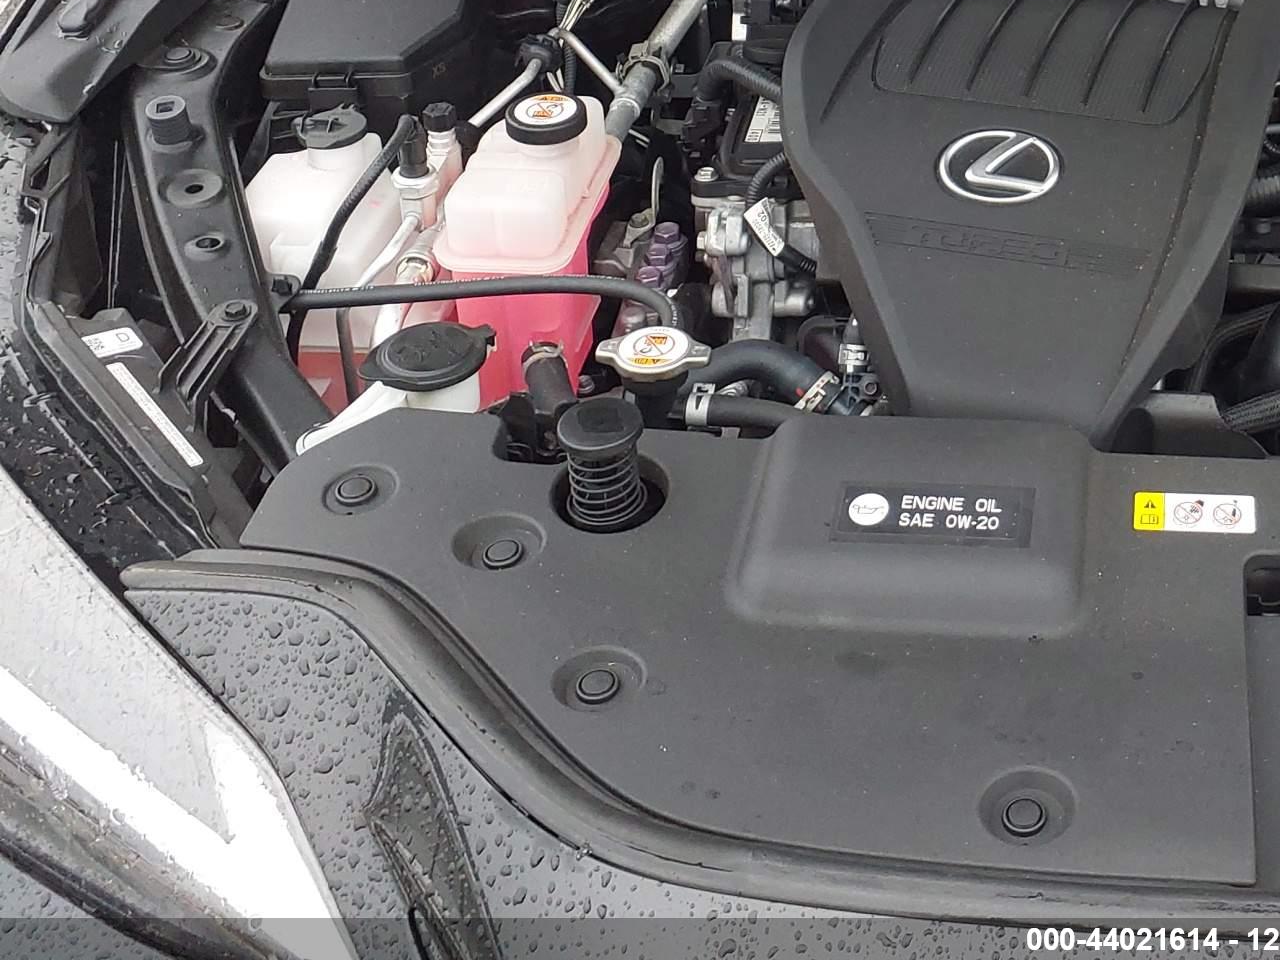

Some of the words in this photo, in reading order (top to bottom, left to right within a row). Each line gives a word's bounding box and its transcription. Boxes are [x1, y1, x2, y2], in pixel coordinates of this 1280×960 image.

[901, 495, 965, 511] ENGINE
[975, 499, 1002, 513] OIL
[898, 513, 935, 528] SAE
